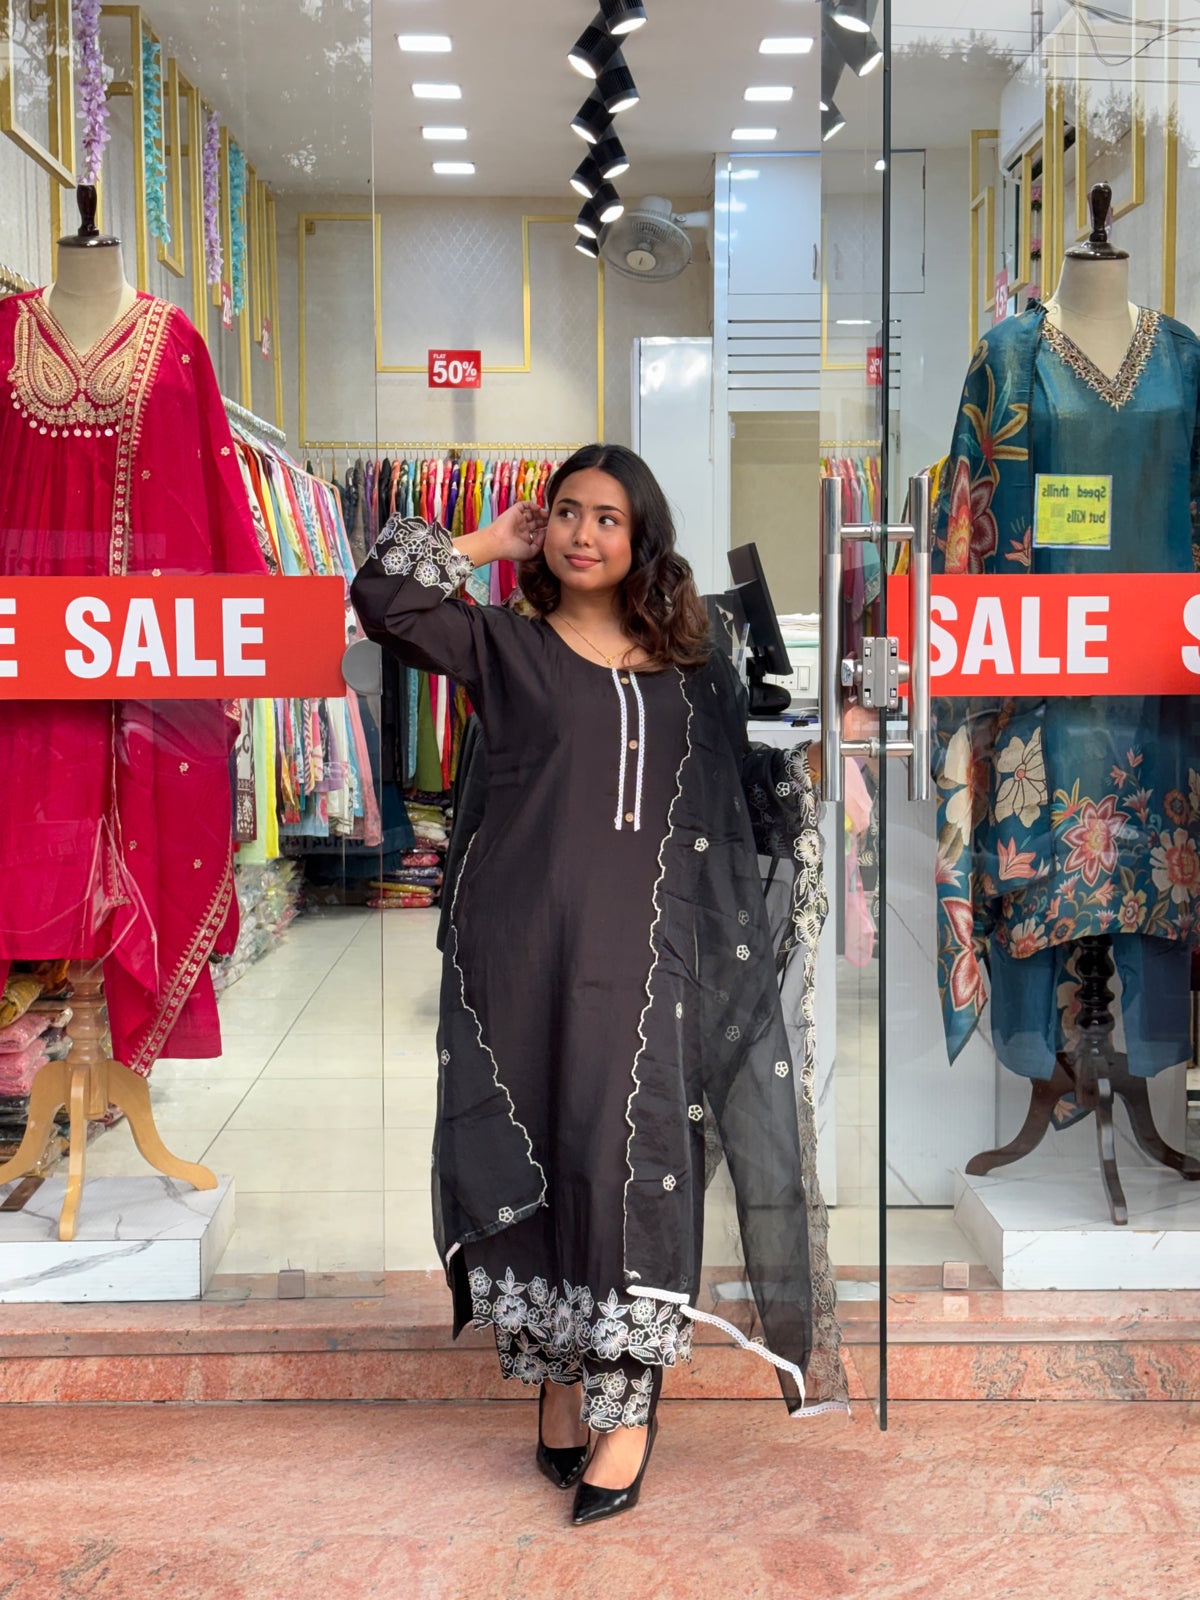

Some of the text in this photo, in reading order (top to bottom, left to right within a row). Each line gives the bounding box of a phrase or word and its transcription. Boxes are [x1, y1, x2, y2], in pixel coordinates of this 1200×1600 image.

[432, 360, 477, 384] 50%
[65, 596, 266, 679] SALE
[930, 595, 1109, 677] SALE
